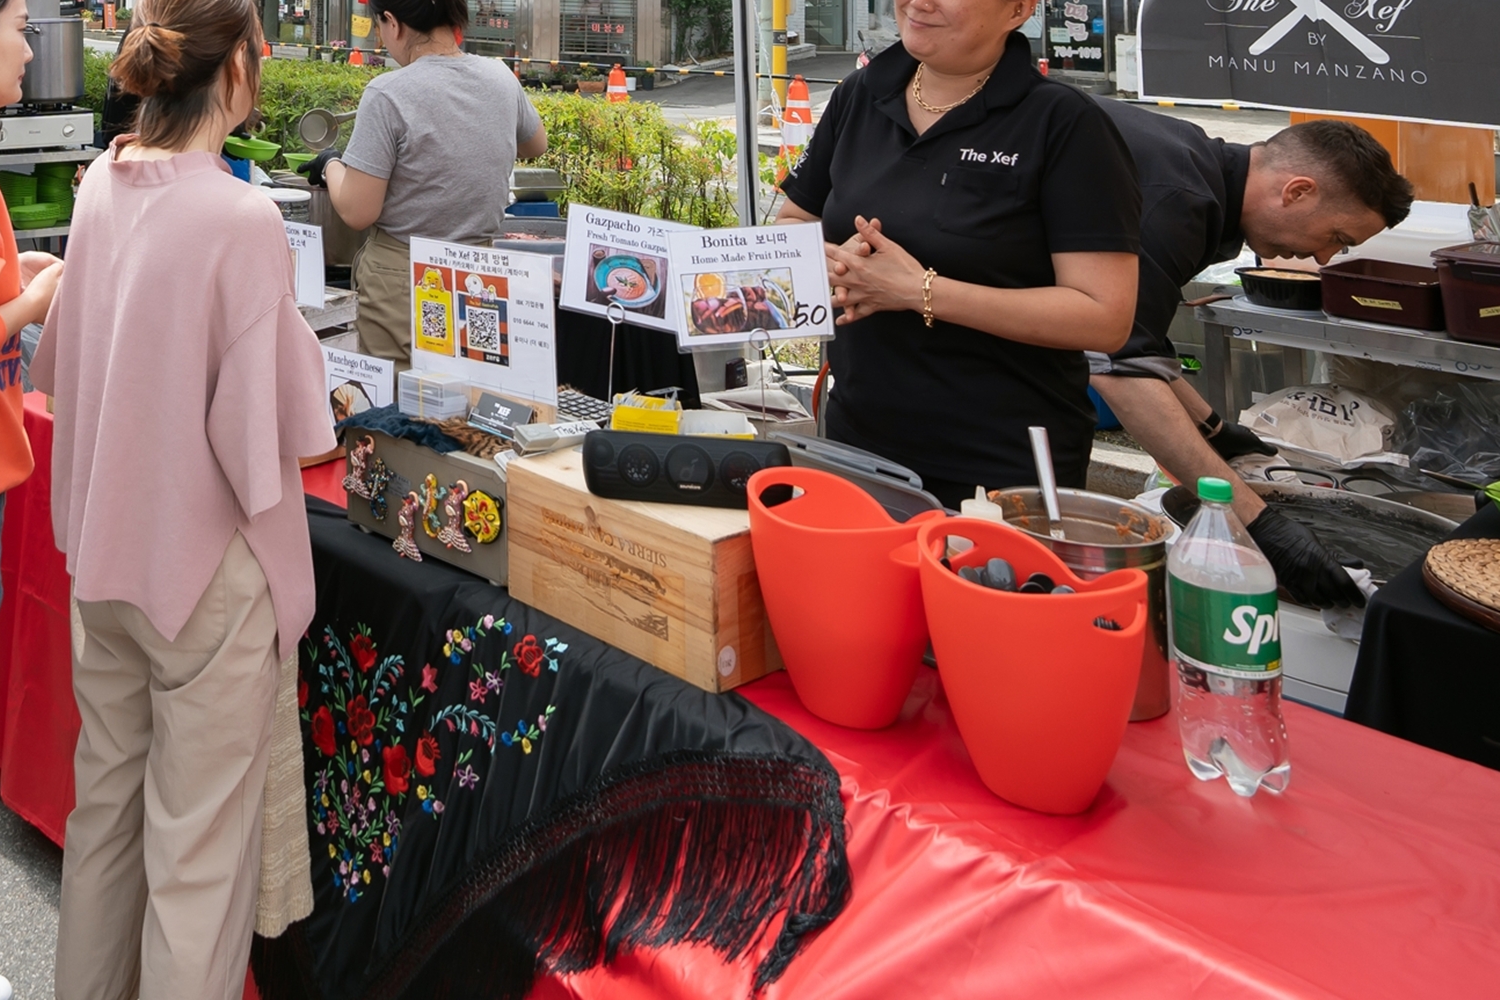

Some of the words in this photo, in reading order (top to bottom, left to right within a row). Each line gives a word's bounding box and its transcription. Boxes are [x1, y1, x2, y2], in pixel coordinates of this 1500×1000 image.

[1308, 32, 1326, 46] BY
[1209, 55, 1276, 73] MANU
[1294, 61, 1428, 85] MANZANO
[959, 148, 987, 163] The
[990, 150, 1019, 167] Xef
[585, 212, 641, 234] Gazpacho
[586, 229, 608, 243] Fresh
[610, 233, 639, 249] Tomato
[701, 234, 748, 249] Bonita
[755, 232, 788, 246] 보니따
[444, 247, 456, 259] The
[459, 249, 470, 259] Xef
[472, 251, 489, 264] 결제
[492, 255, 509, 266] 방법
[691, 255, 719, 265] Home
[721, 251, 746, 263] Made
[748, 250, 771, 261] Fruit
[773, 248, 802, 259] Drink
[327, 351, 358, 368] Manchego
[360, 359, 383, 374] Cheese
[617, 537, 667, 568] SIERRA
